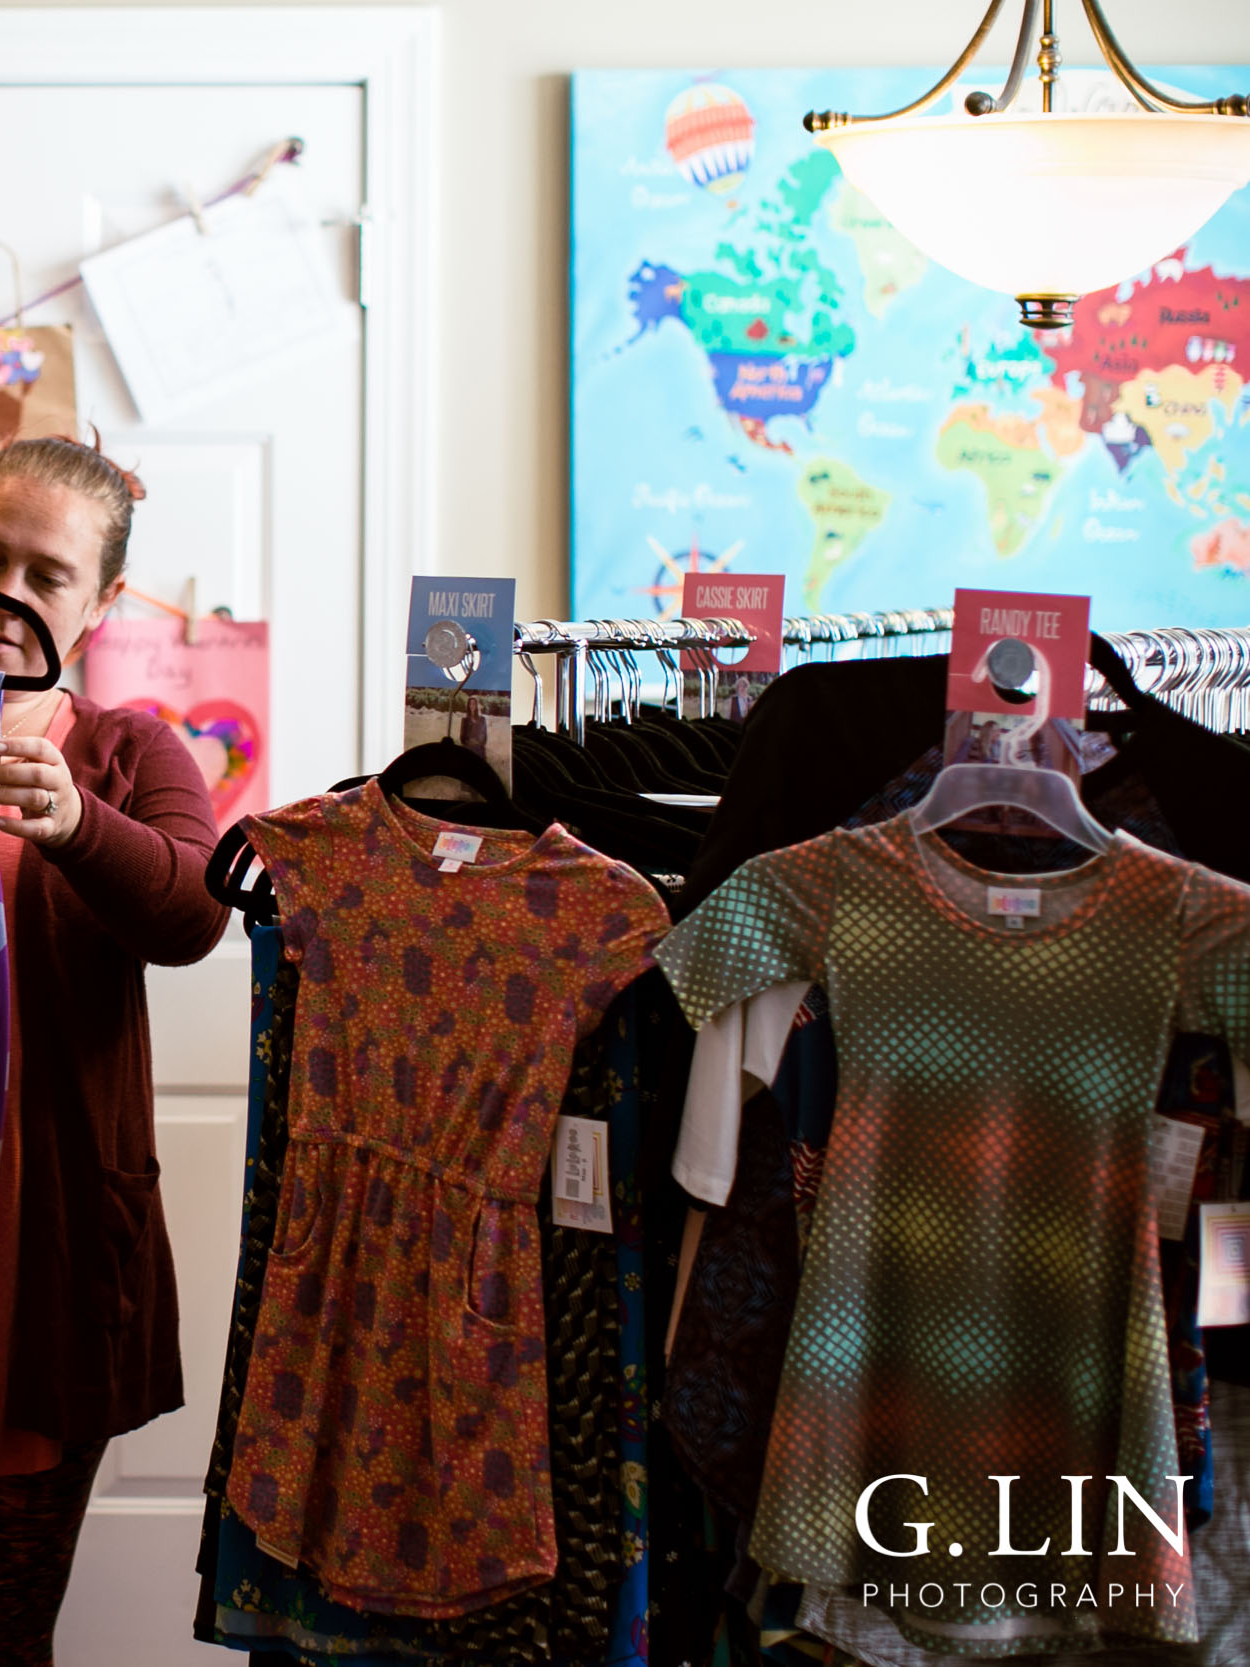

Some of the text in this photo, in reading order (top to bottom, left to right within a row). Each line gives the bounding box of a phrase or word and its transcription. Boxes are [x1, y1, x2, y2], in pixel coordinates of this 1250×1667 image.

[428, 591, 496, 618] MAXI SKIRT
[695, 585, 769, 609] CASSIE SKIRT
[979, 607, 1062, 639] RANDY TEE
